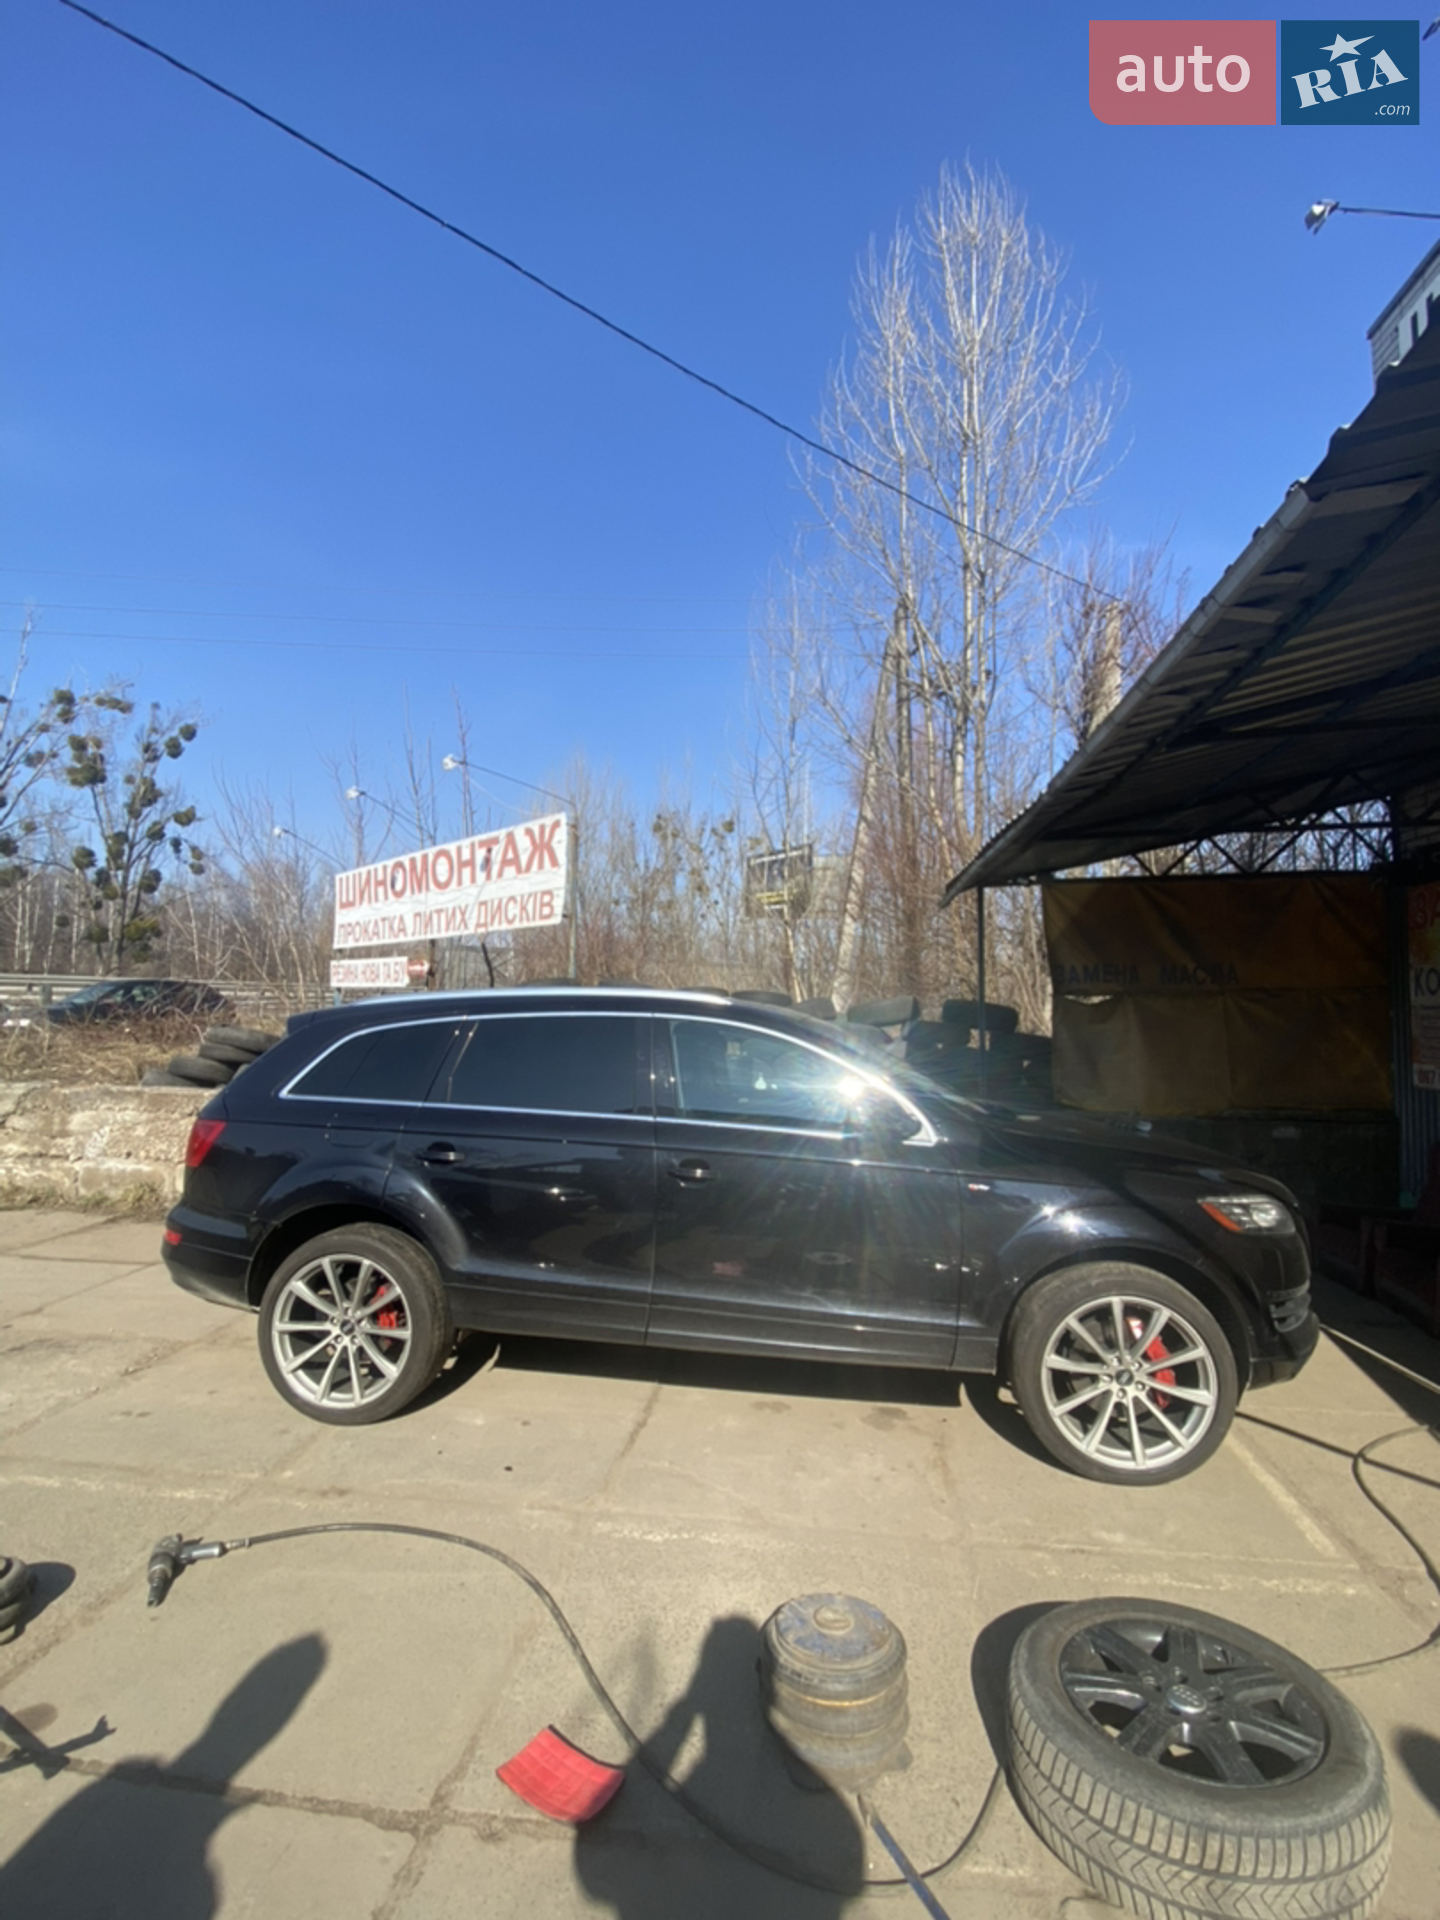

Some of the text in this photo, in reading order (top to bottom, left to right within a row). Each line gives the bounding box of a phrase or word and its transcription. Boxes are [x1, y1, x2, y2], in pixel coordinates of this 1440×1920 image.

[338, 819, 561, 910] ШИНОМОНТАЖ
[337, 889, 555, 945] ПРОКАТКА ЛИТИХ ДИСКІВ
